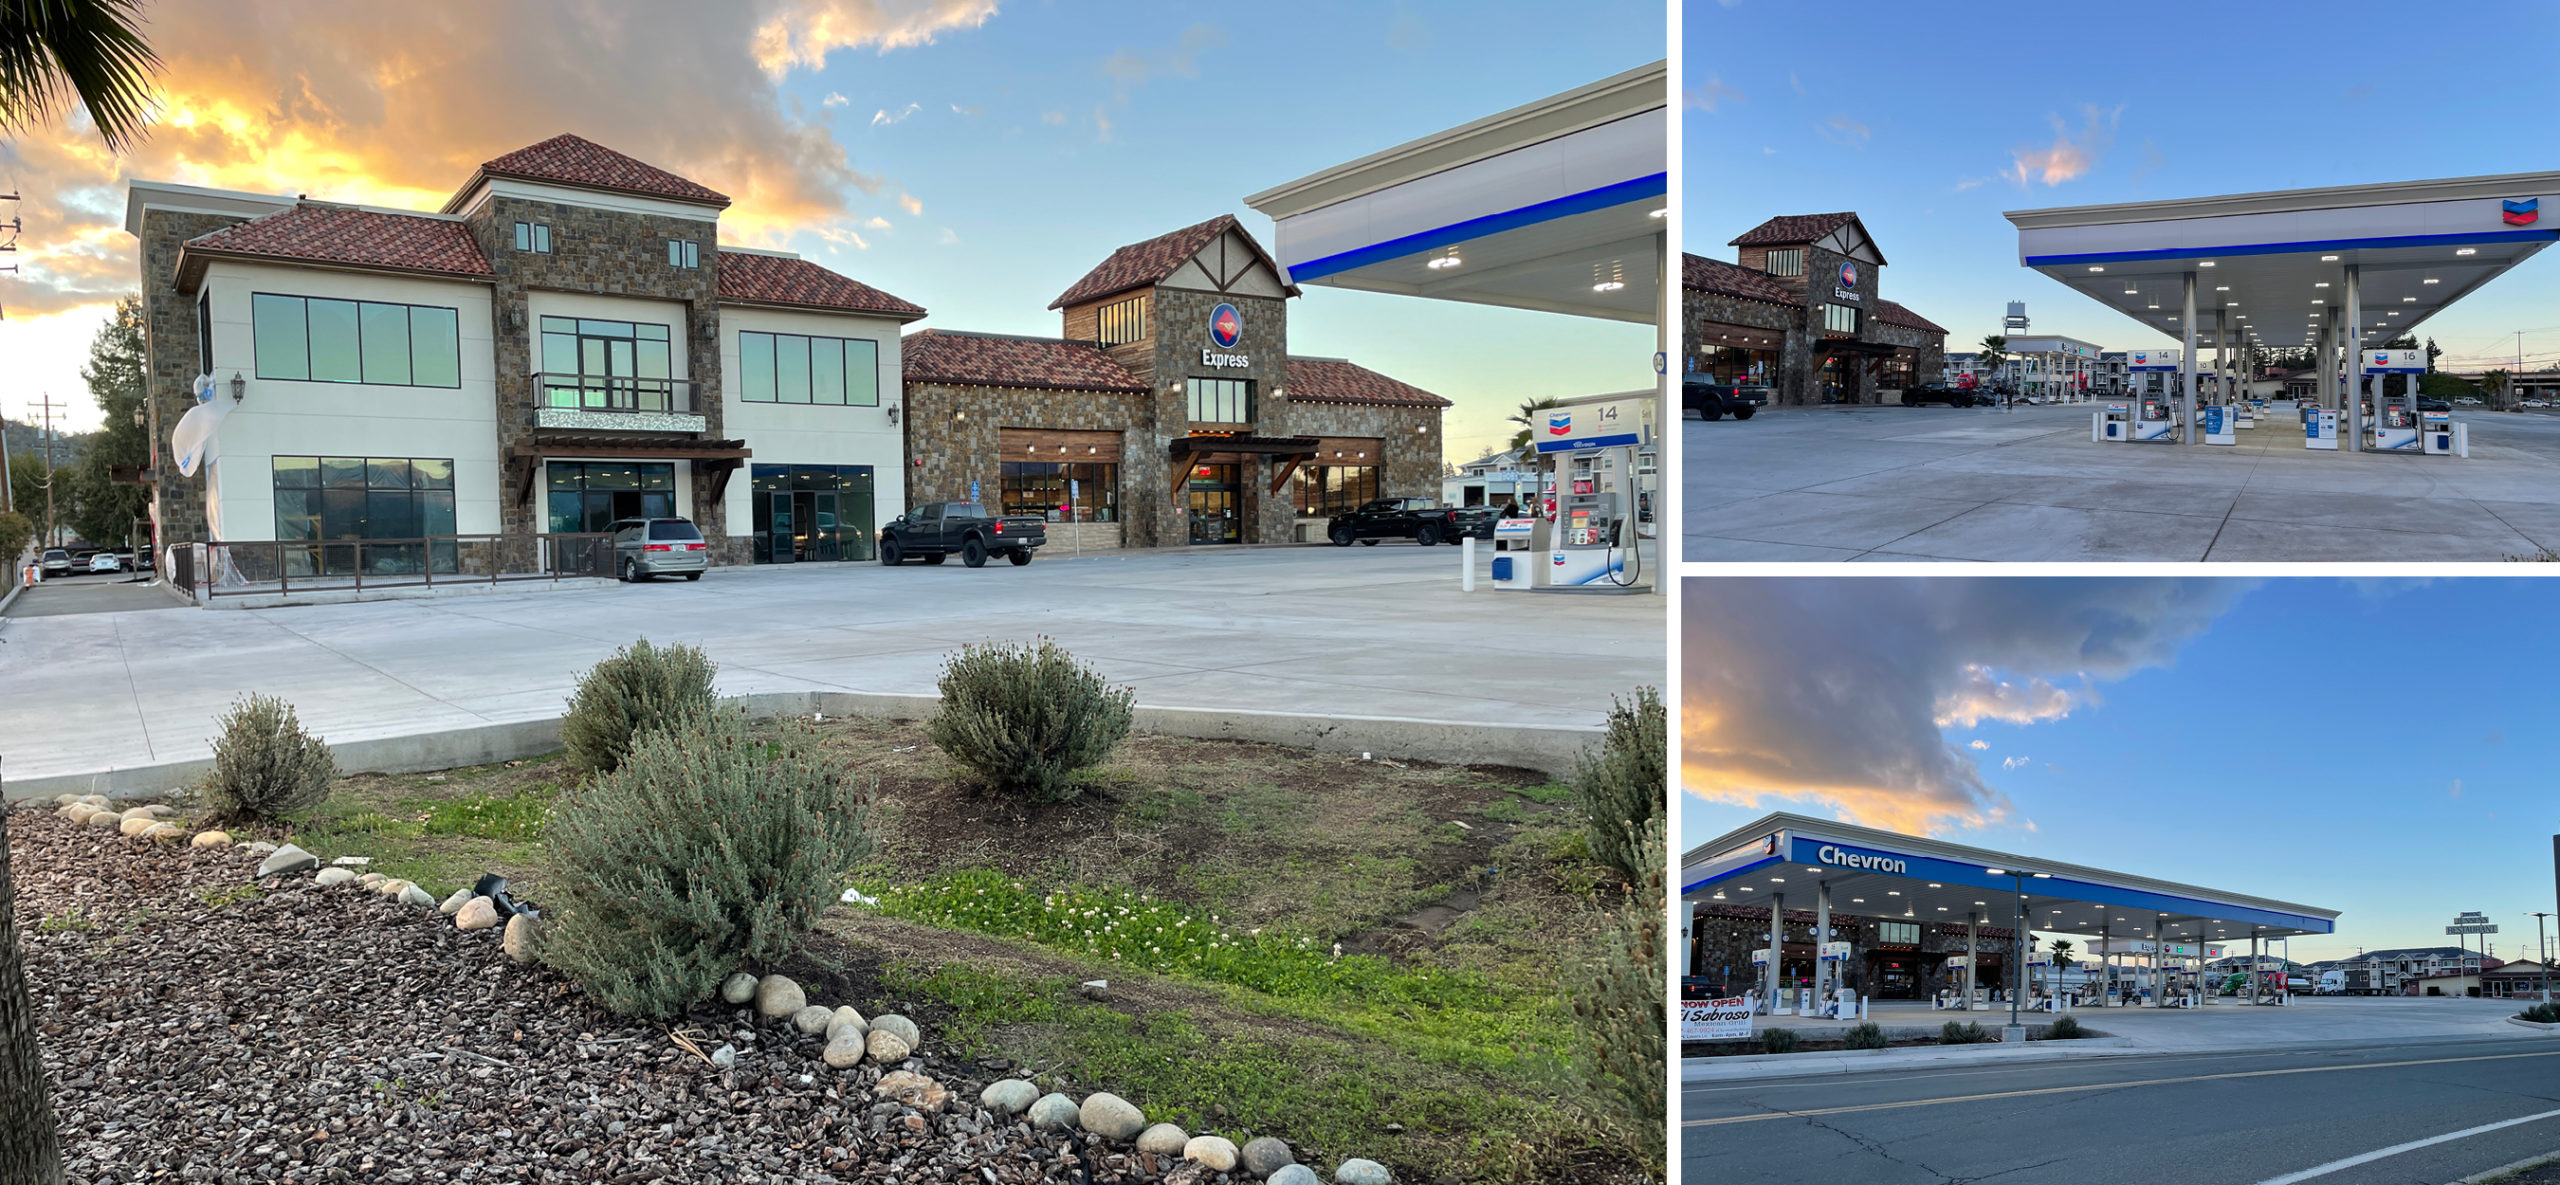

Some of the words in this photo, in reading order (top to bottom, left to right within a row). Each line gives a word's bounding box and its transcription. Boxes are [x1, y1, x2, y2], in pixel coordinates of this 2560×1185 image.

[1835, 287, 1860, 301] Express
[1202, 349, 1249, 369] Express
[2158, 351, 2168, 359] 14
[2403, 352, 2415, 360] 16
[1598, 406, 1618, 422] 14
[1818, 845, 1906, 874] Chevron
[2447, 925, 2496, 935] RESTAURANT
[1681, 1000, 1709, 1008] NOW
[1711, 997, 1744, 1008] OPEN
[1690, 1008, 1750, 1022] Sabroso
